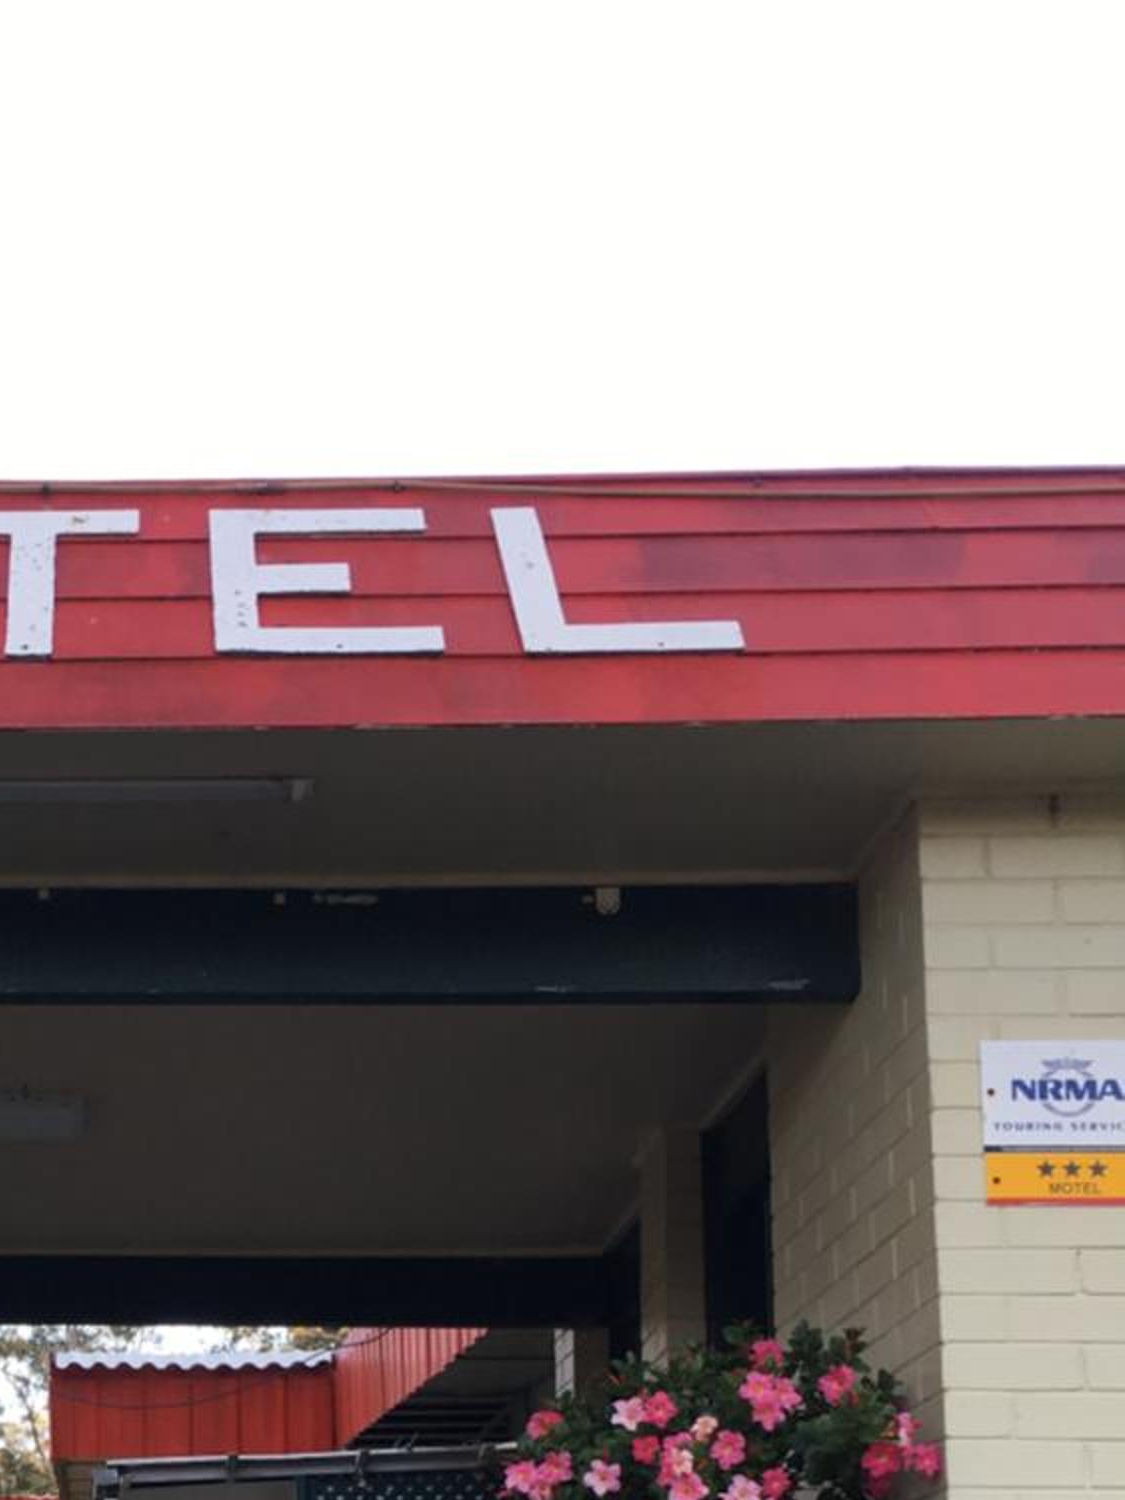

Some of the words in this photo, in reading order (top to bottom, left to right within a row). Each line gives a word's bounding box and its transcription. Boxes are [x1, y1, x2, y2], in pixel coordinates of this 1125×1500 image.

[1011, 1078, 1125, 1101] NRMA
[994, 1121, 1063, 1132] TOURING
[1049, 1182, 1101, 1195] MOTEL
